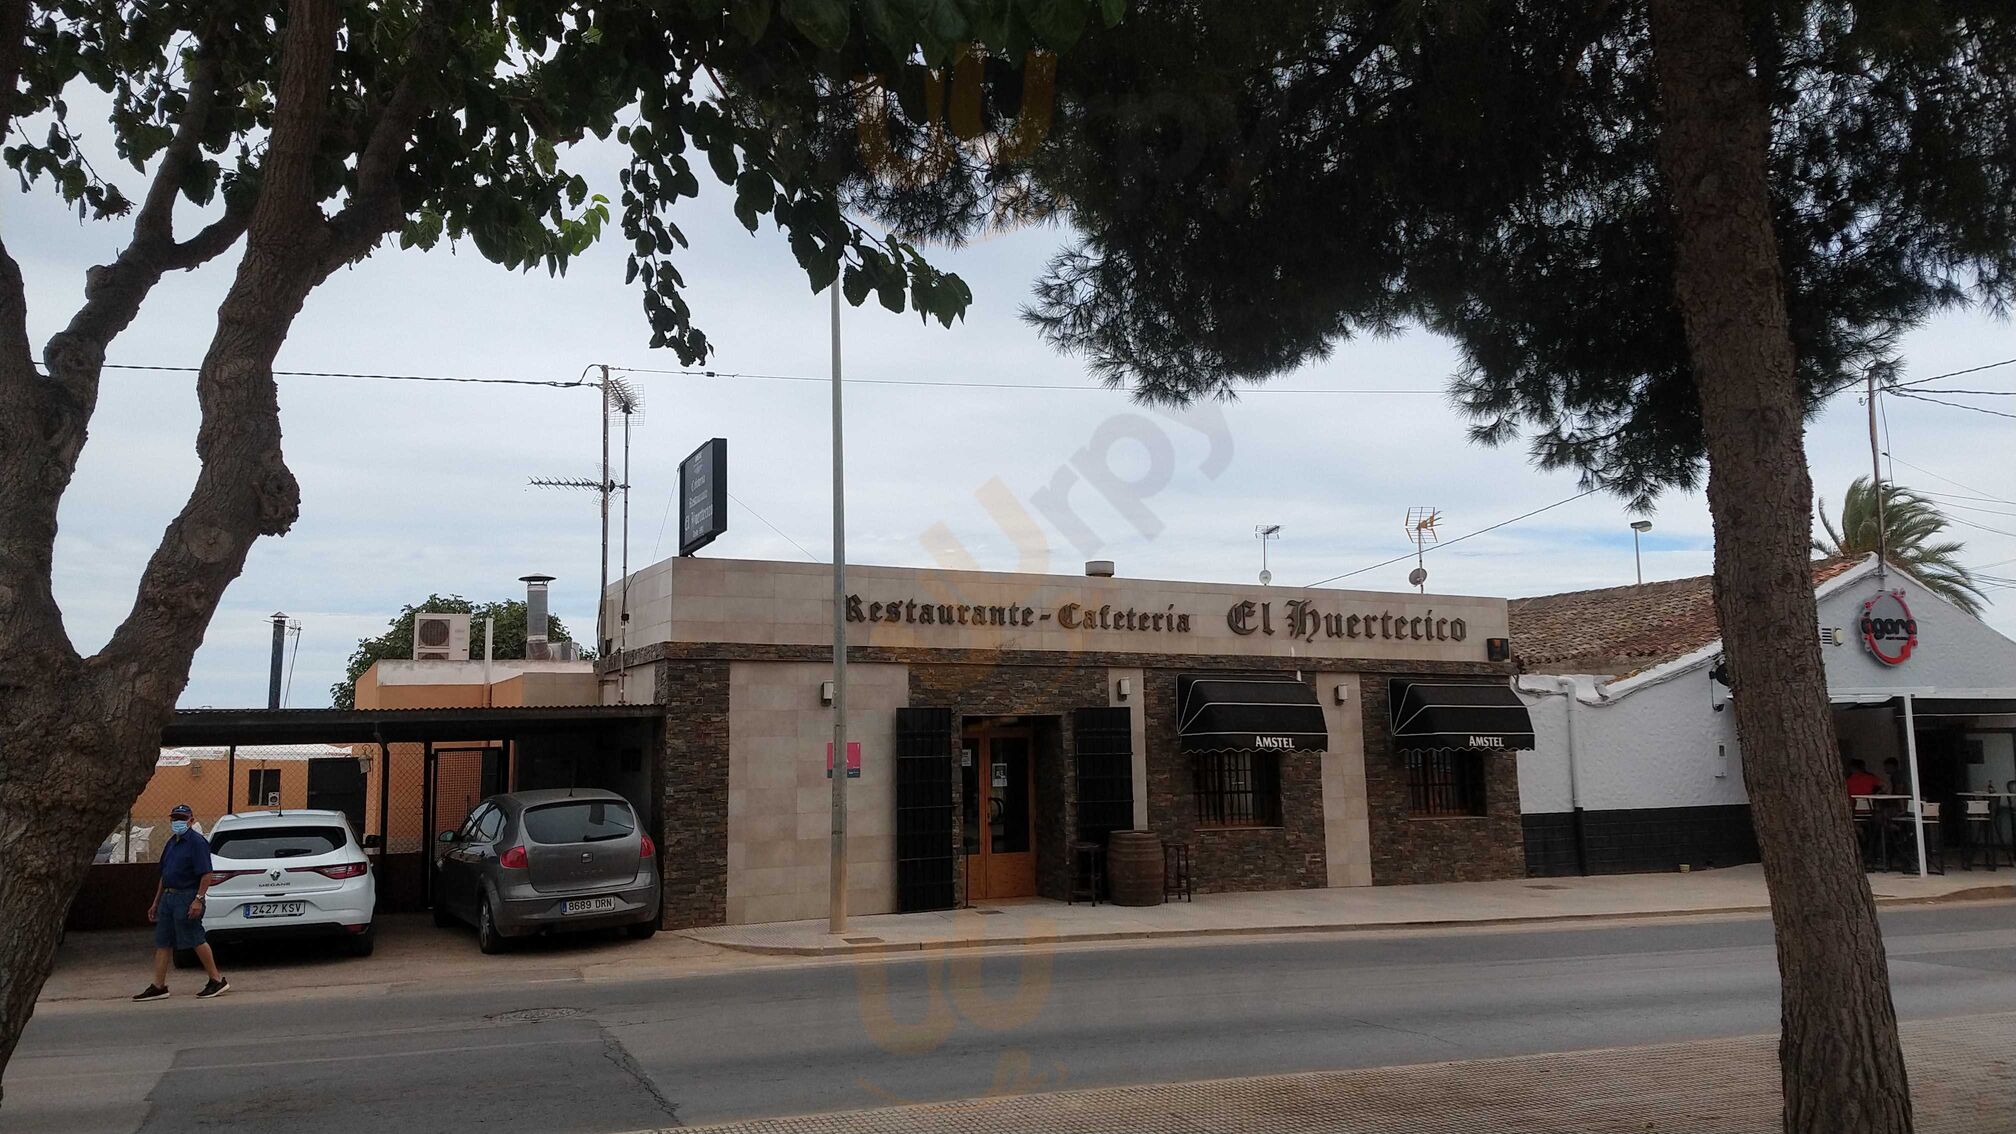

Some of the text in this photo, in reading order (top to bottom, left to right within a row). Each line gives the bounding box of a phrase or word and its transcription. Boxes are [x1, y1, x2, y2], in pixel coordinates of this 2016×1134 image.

[1226, 600, 1276, 636] El
[1255, 735, 1296, 749] AMSTEL
[1469, 735, 1505, 747] AMSTEL
[252, 903, 302, 915] 2427 KSV
[568, 898, 612, 911] 8689 DRN
